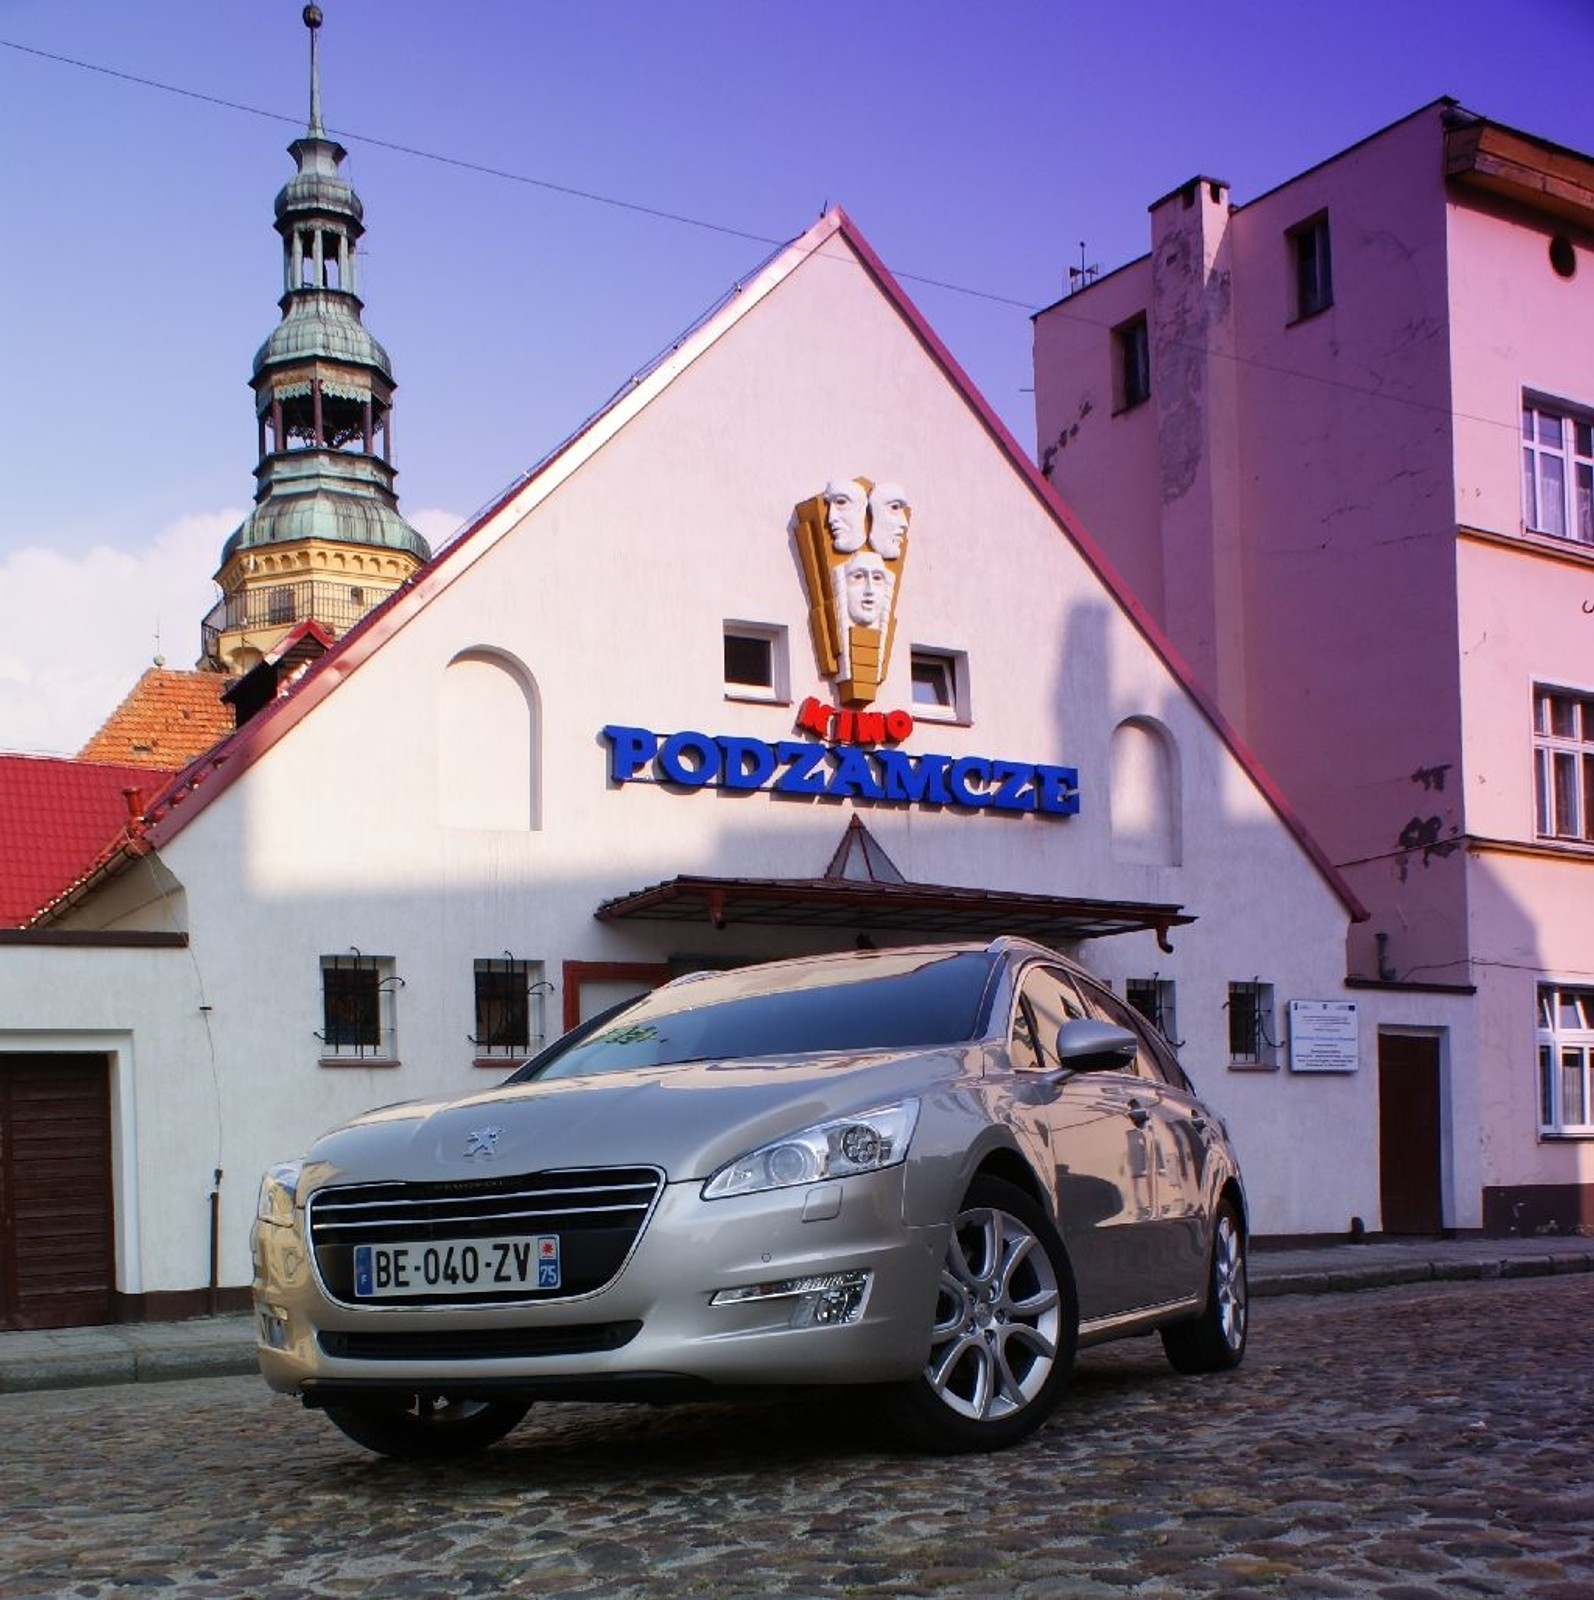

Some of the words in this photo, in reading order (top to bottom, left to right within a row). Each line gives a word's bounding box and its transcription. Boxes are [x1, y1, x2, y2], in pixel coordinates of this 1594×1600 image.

[797, 696, 913, 743] KINO
[603, 725, 1080, 814] PODZAMCZE
[376, 1242, 531, 1288] BE-040-ZV
[539, 1265, 557, 1284] 75
